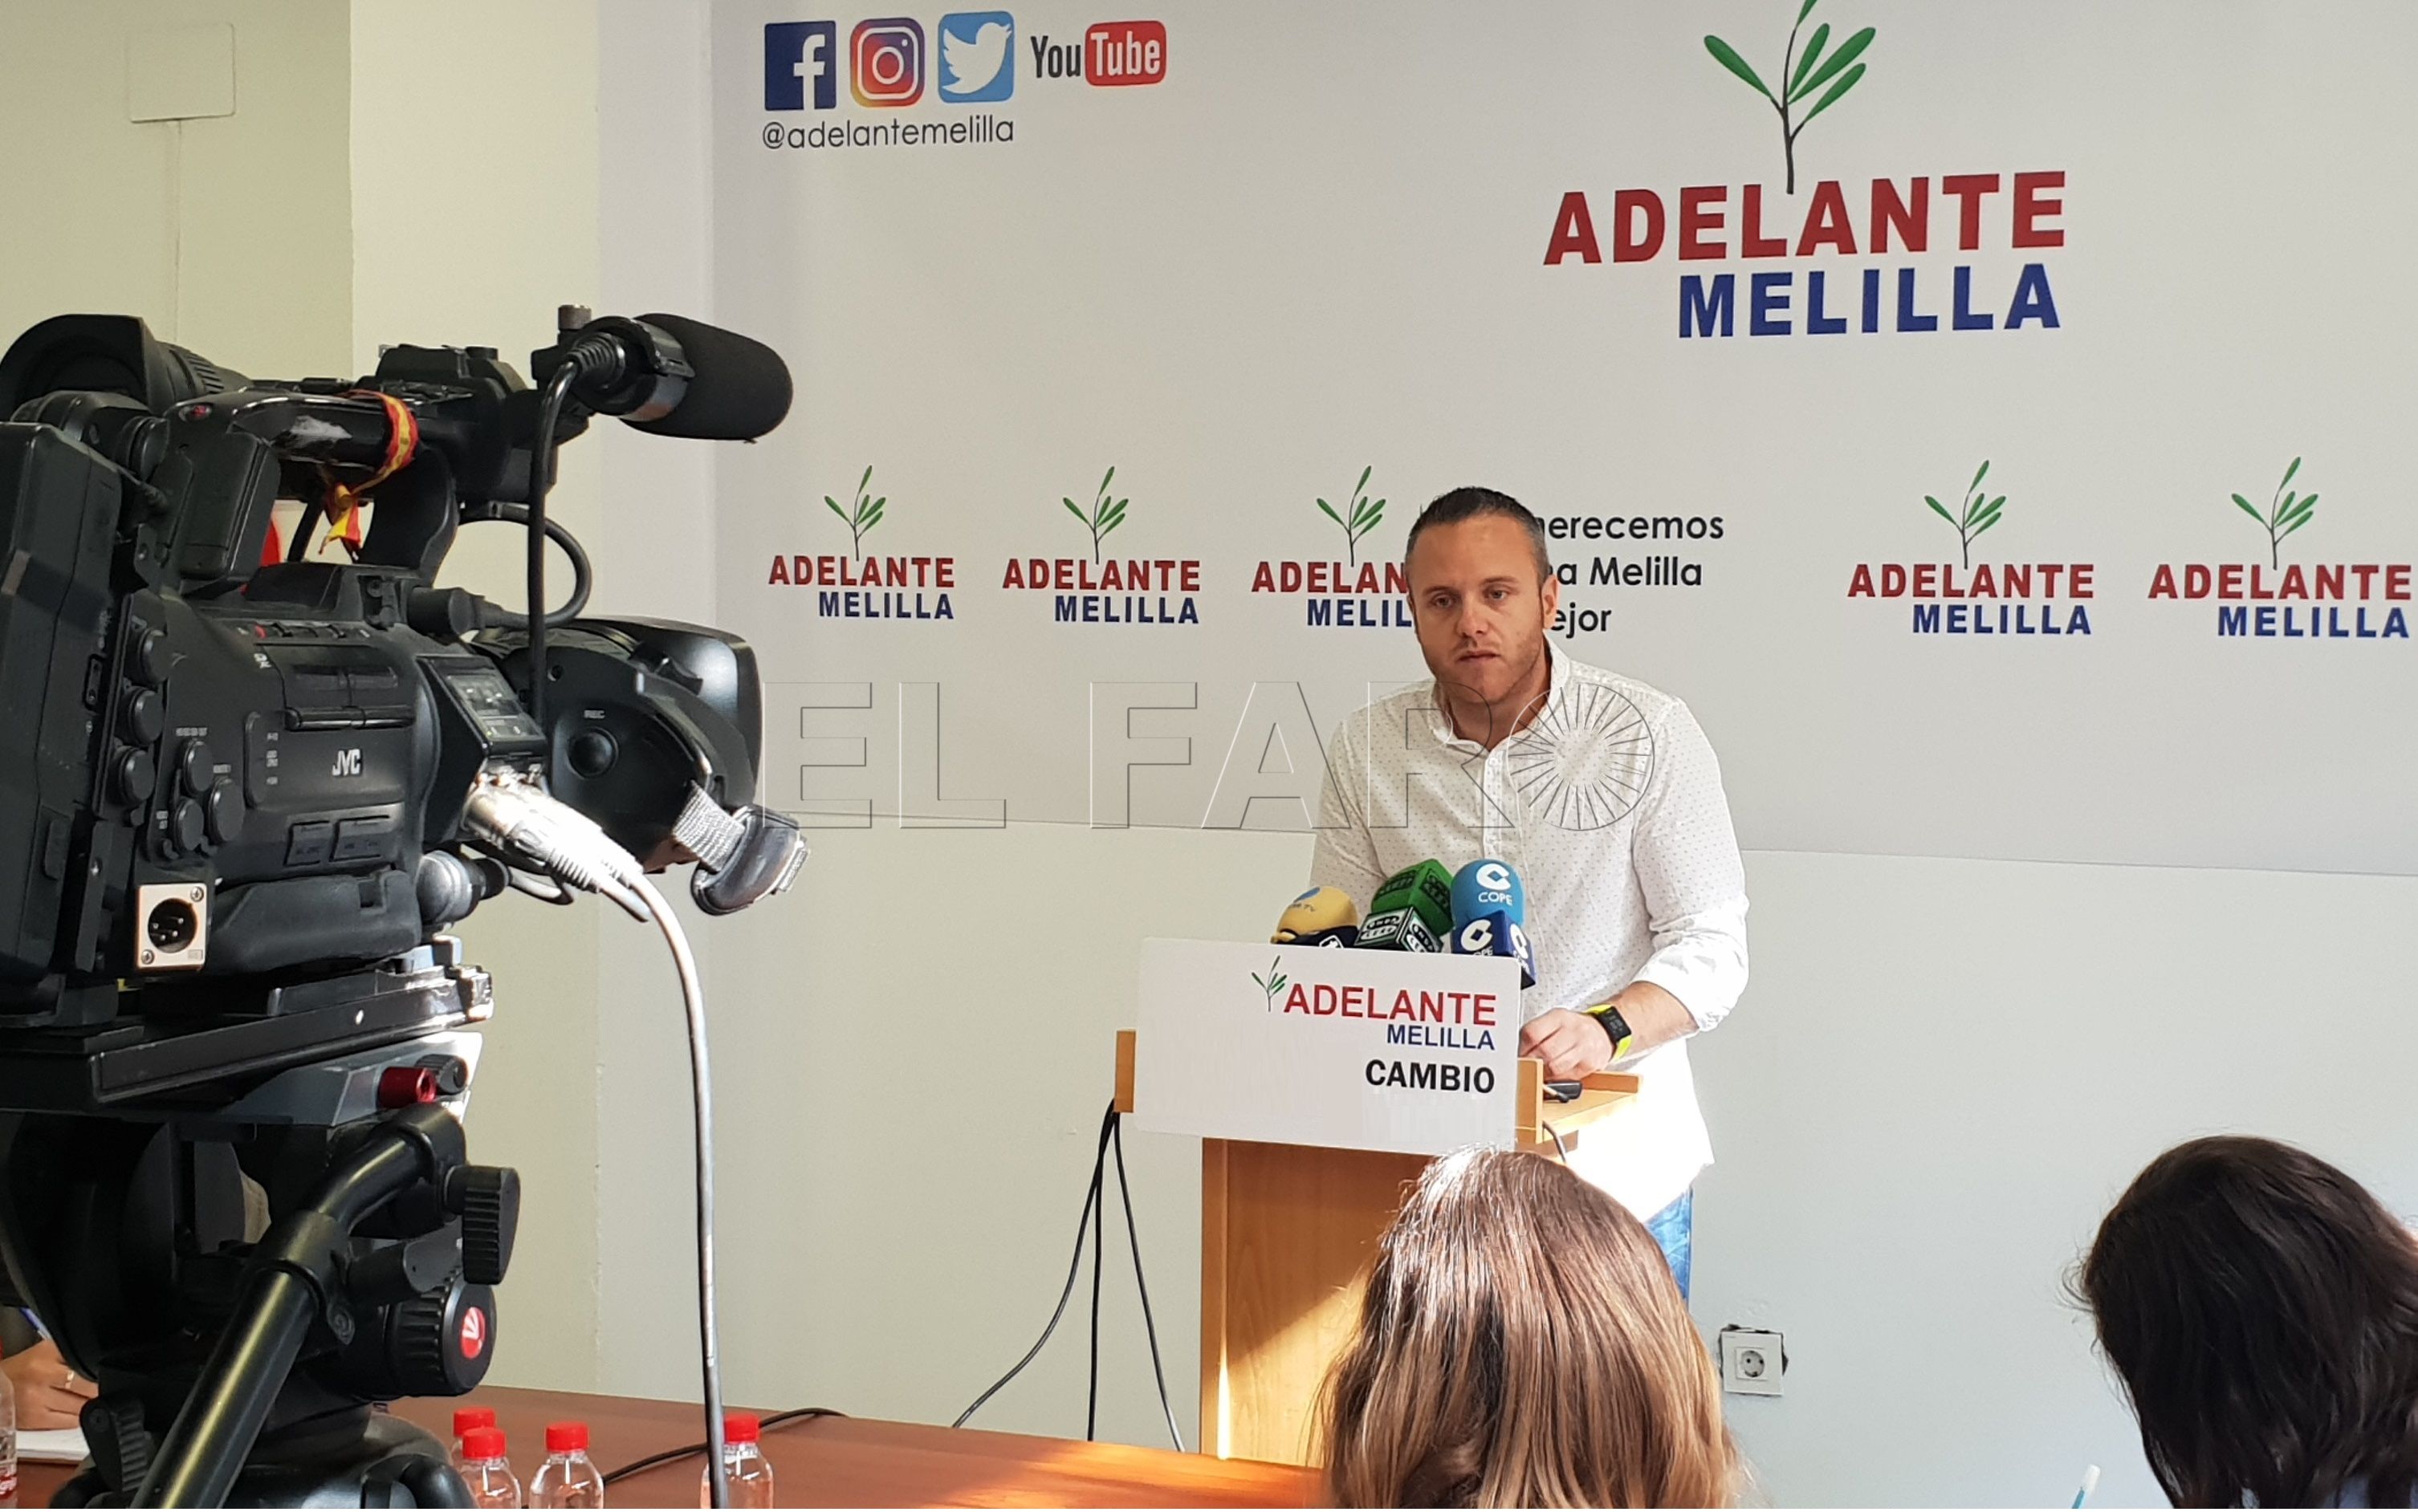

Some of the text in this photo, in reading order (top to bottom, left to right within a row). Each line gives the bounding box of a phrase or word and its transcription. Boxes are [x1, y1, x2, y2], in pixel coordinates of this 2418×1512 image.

[762, 115, 1015, 150] @adelantemelilla
[1543, 170, 2066, 266] ADELANTE
[1679, 262, 2061, 339] MELILLA
[768, 555, 955, 588] ADELANTE
[1003, 559, 1201, 592] ADELANTE
[1251, 561, 1409, 594] ADELAN
[1589, 555, 1703, 587] Melilla
[1846, 563, 2094, 600] ADELANTE
[2147, 563, 2412, 601] ADELANTE
[819, 591, 955, 620] MELILLA
[1055, 595, 1199, 624] MELILLA
[1307, 599, 1413, 628] MELIL
[1551, 602, 1613, 640] ejor
[1912, 604, 2092, 636] MELILLA
[2217, 606, 2410, 639] MELILLA
[332, 748, 362, 777] JVC
[1478, 891, 1513, 907] COPE
[1283, 983, 1498, 1027] ADELANTE
[1386, 1023, 1496, 1051] MELILLA
[1365, 1058, 1496, 1094] CAMBIO
